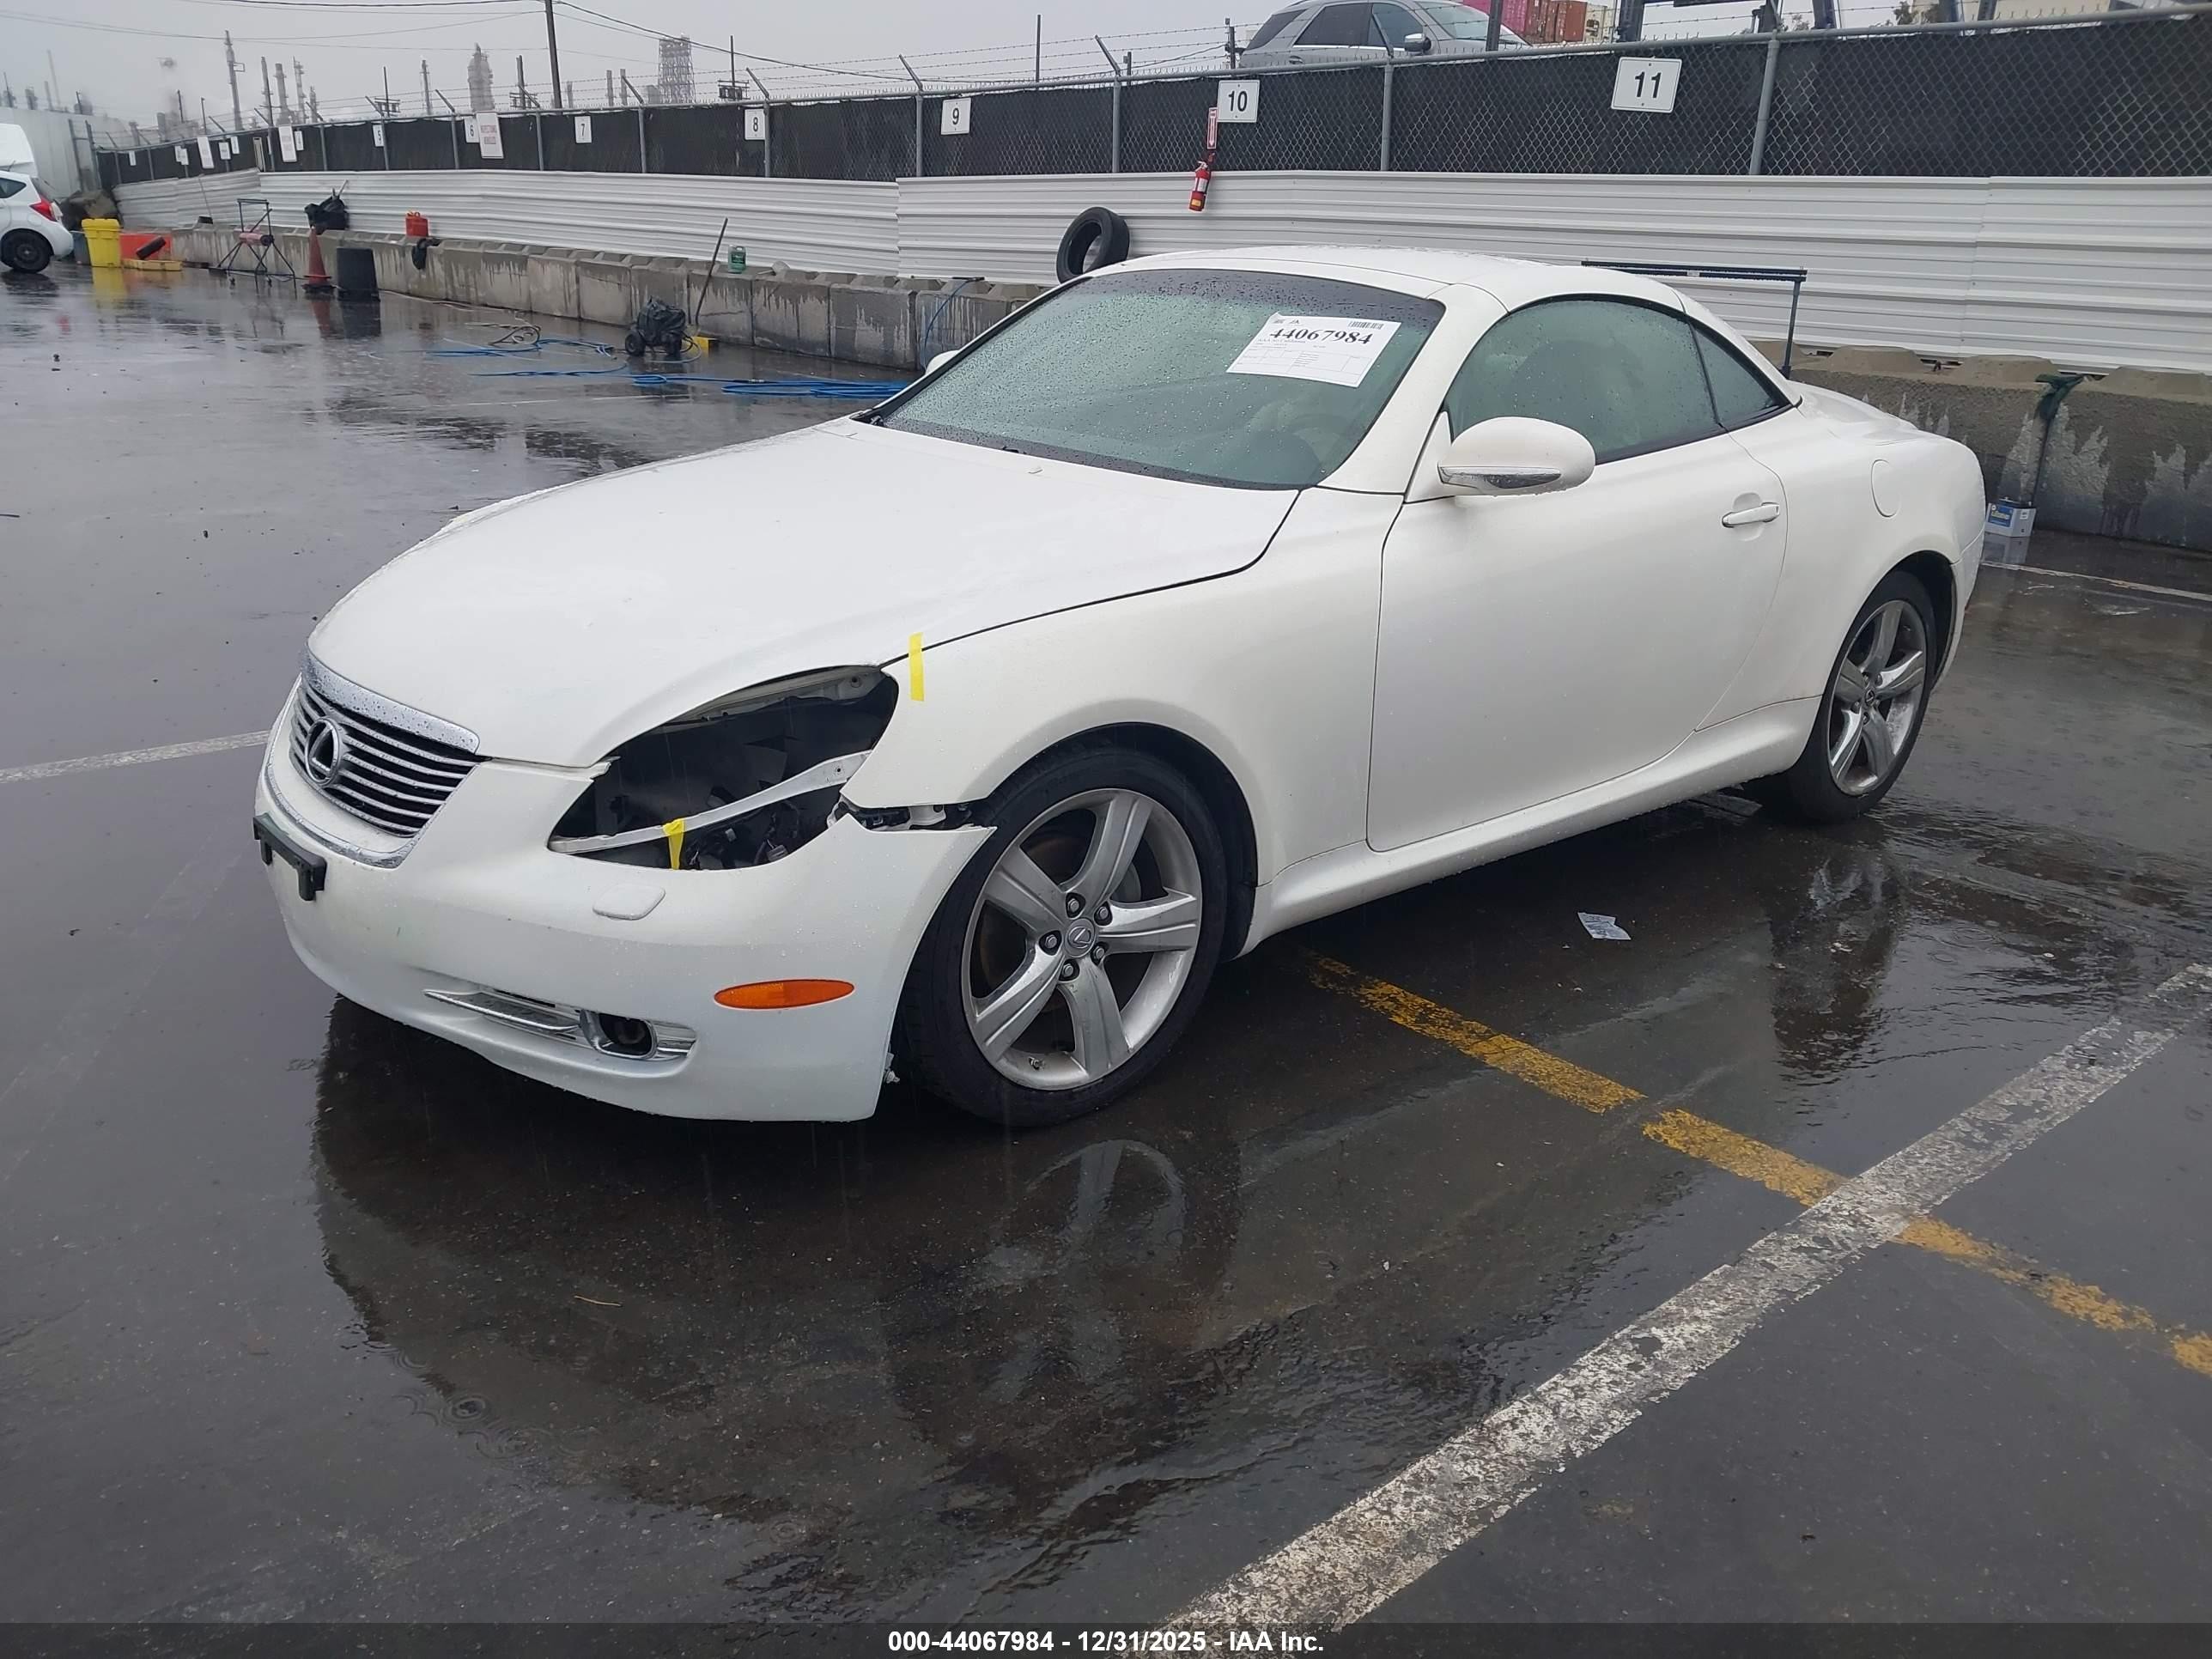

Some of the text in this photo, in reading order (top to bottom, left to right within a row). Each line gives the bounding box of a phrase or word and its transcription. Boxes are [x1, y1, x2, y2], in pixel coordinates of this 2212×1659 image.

[1634, 71, 1662, 99] 11
[1228, 90, 1248, 112] 10
[952, 107, 960, 125] 9
[470, 125, 474, 137] 6
[580, 123, 586, 137] 7
[752, 117, 758, 132] 8
[1270, 328, 1374, 344] 44067984
